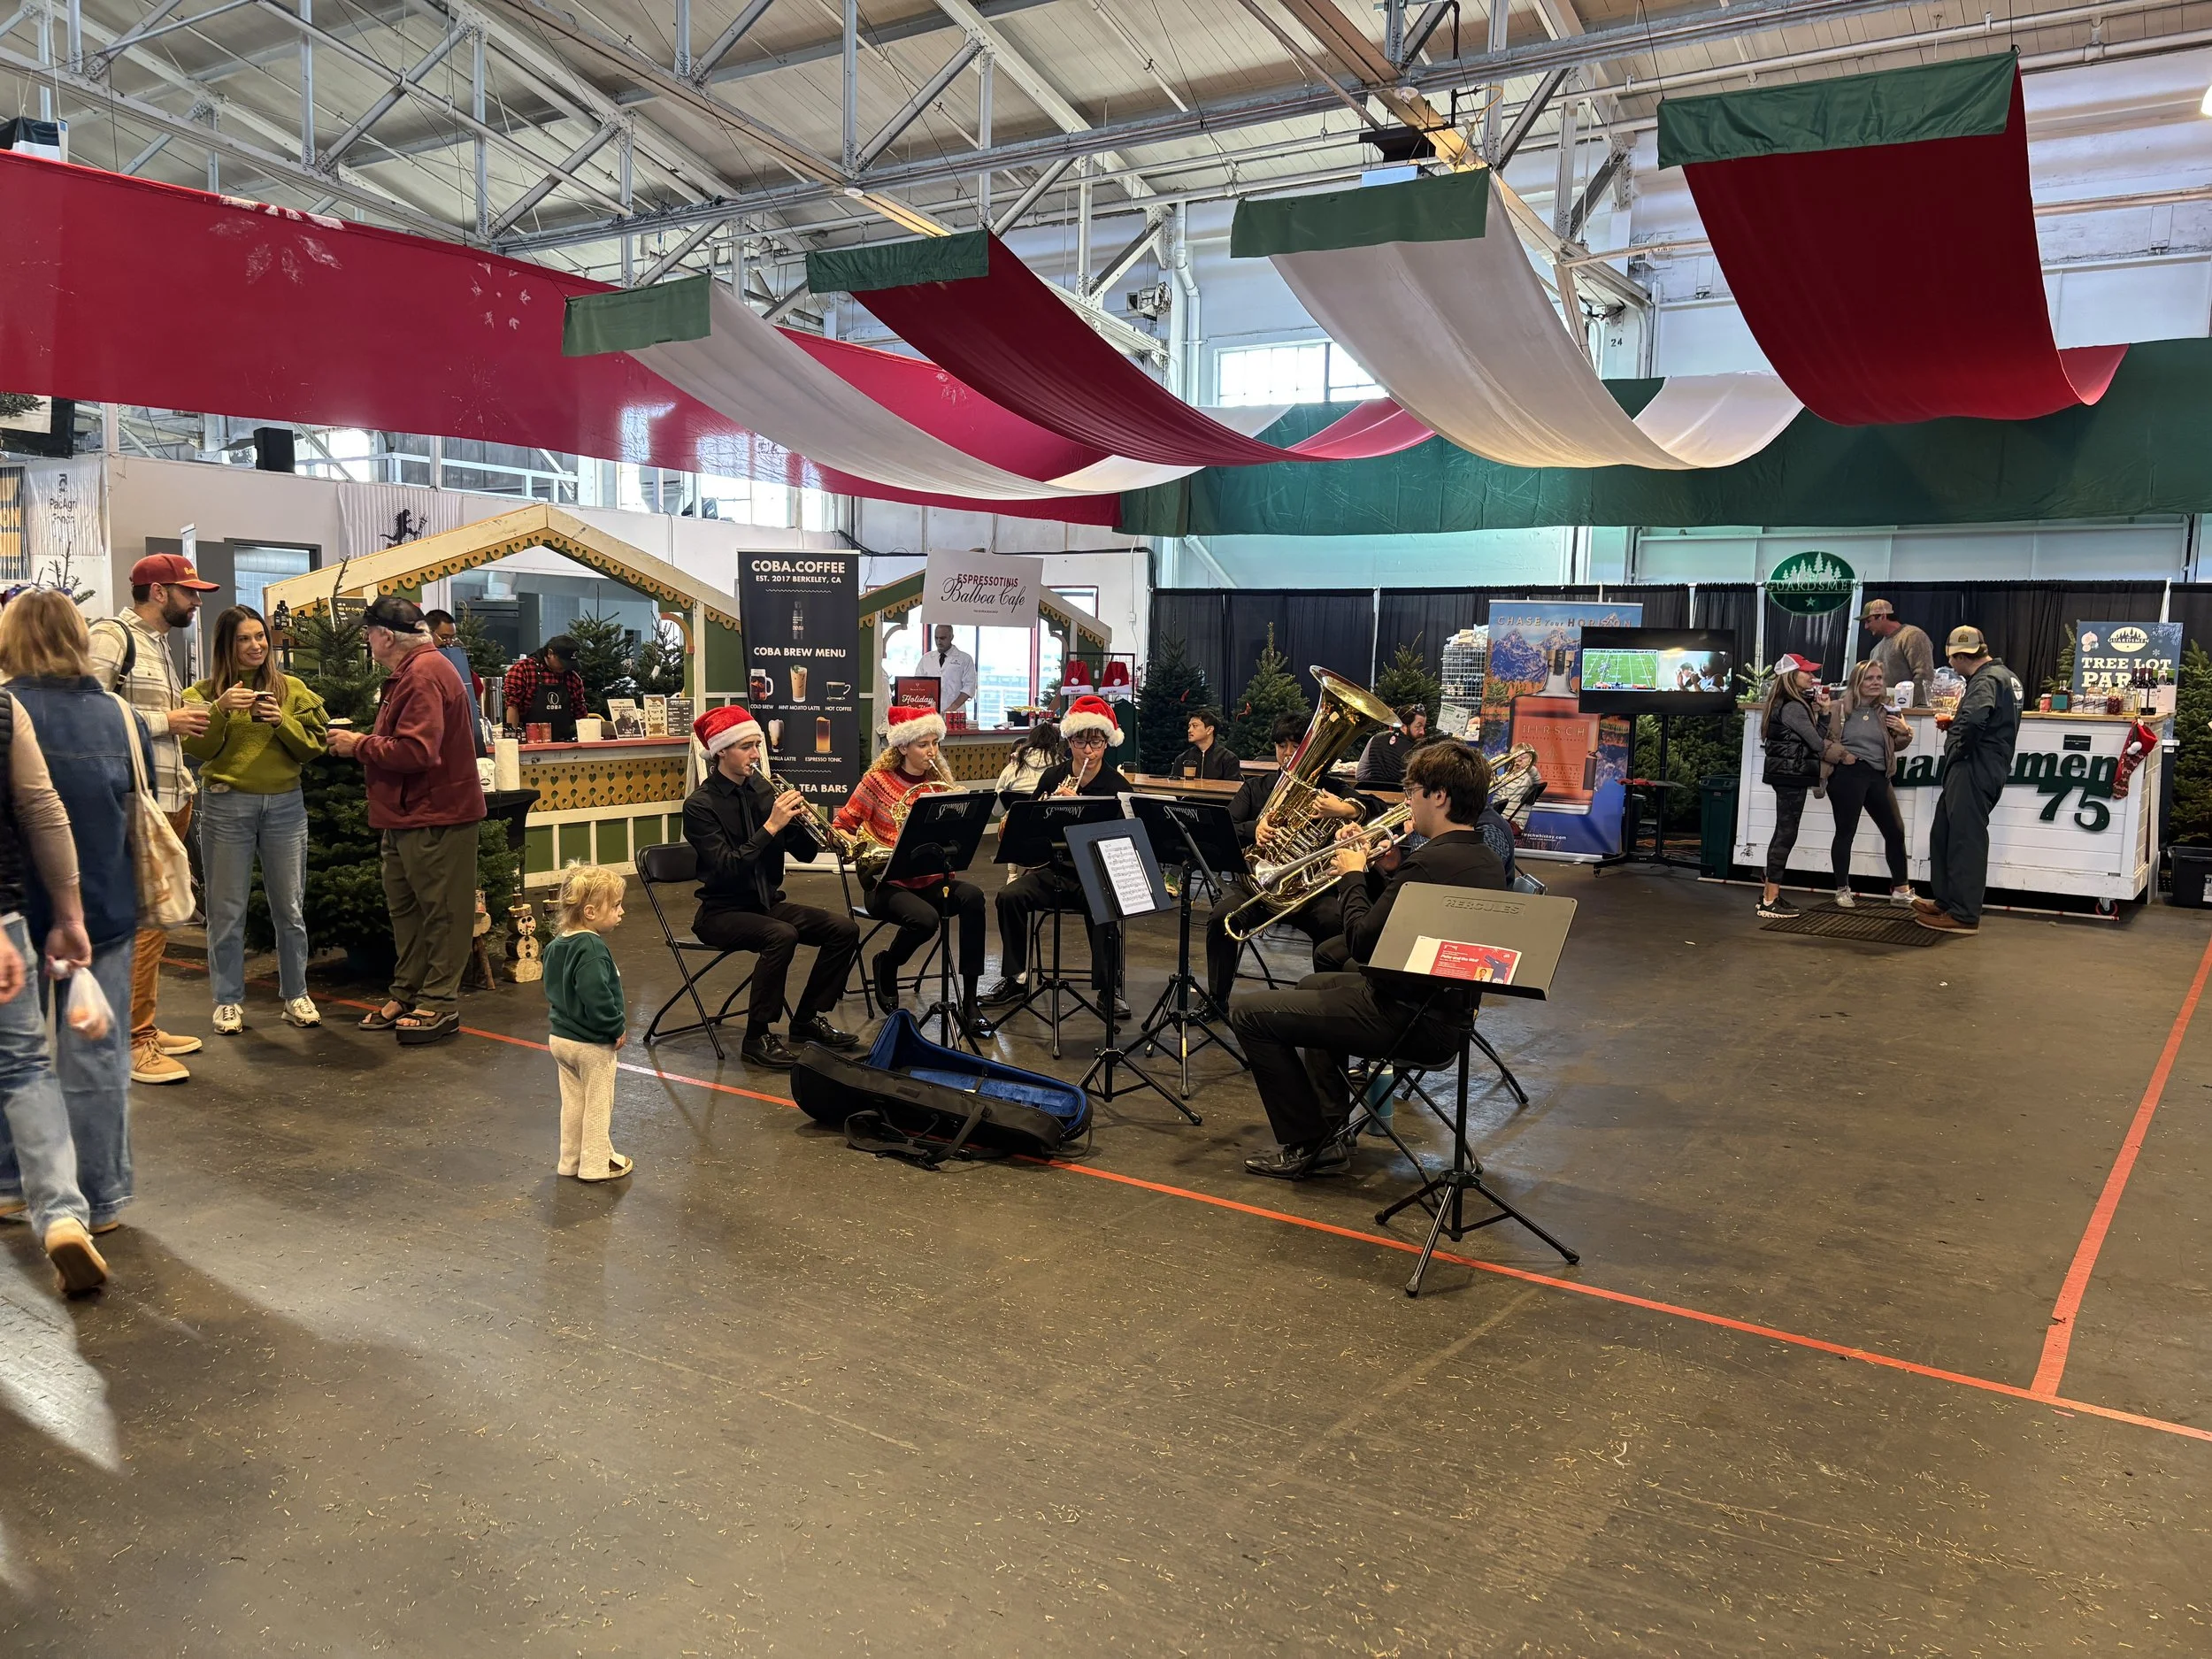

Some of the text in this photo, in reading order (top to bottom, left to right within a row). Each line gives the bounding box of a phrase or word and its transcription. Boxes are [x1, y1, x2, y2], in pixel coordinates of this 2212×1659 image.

[1610, 337, 1623, 347] 24
[751, 560, 846, 573] COBA.COFFEE
[956, 573, 1018, 588] ESPRESSOTINIS
[941, 577, 1026, 613] Balboa Cafe
[1497, 616, 1632, 627] CHASE Your HORIZON
[754, 647, 846, 658] COBA BREW MENU
[2081, 657, 2172, 670] TREE LOT
[2081, 672, 2132, 688] PAR
[902, 694, 934, 704] Holiday
[1523, 725, 1585, 736] HIRSCH
[799, 784, 818, 793] TEA
[820, 784, 848, 794] BARS
[2036, 784, 2111, 832] 75
[1445, 899, 1520, 915] HERCULES
